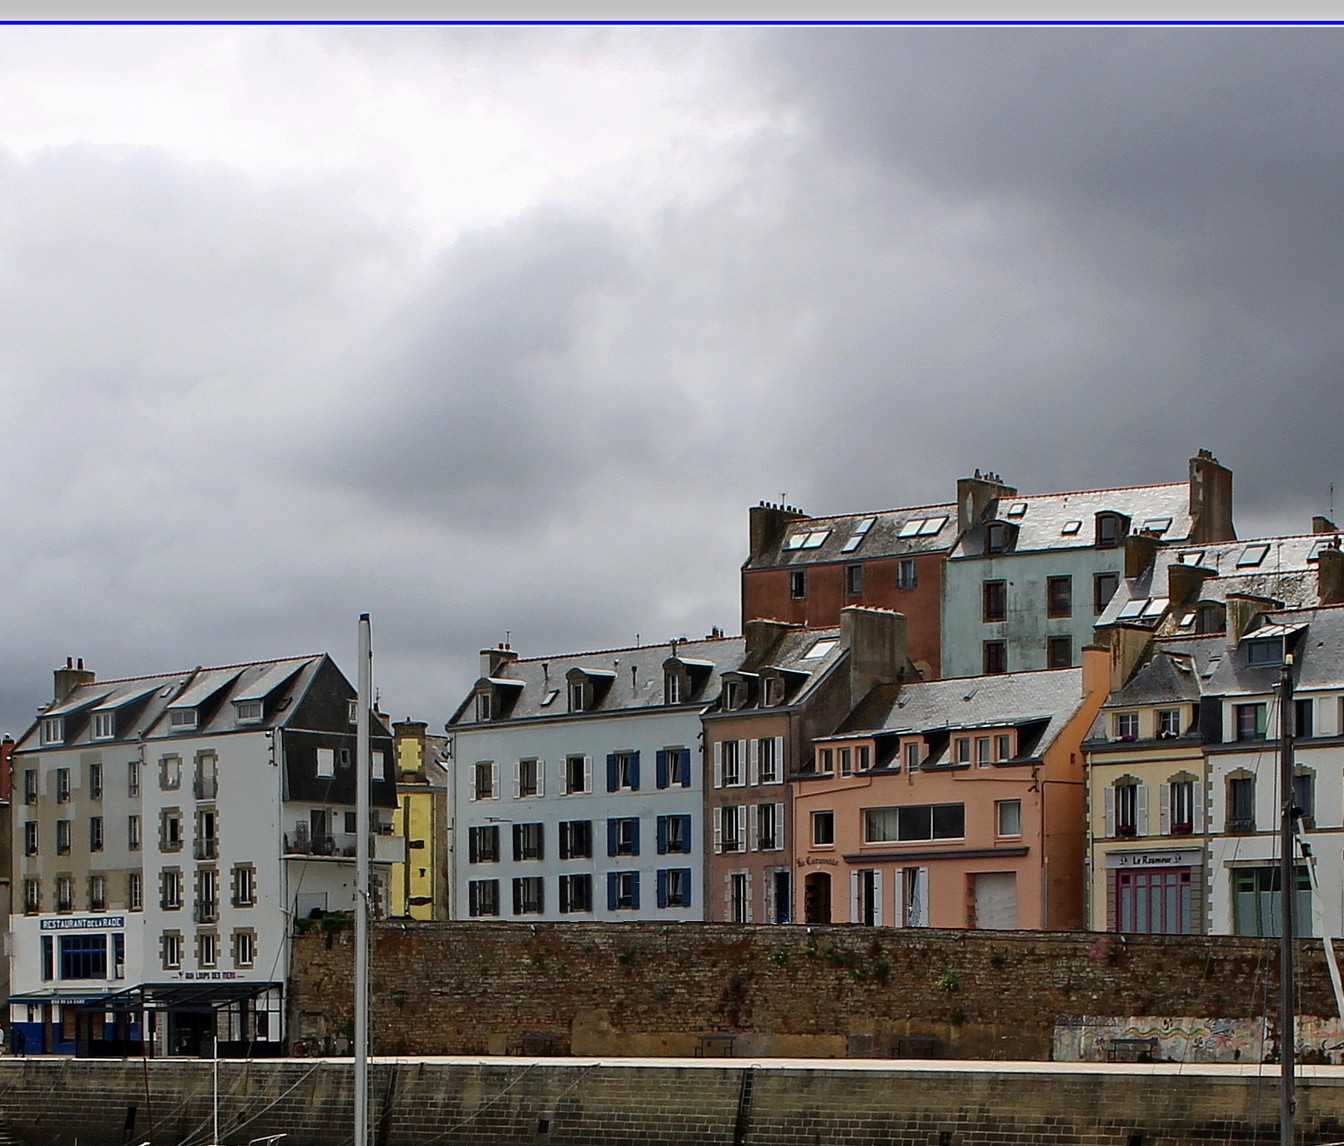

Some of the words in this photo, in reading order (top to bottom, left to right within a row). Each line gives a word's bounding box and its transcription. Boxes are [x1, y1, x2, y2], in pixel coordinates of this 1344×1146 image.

[1132, 856, 1141, 865] Le
[42, 919, 87, 929] RESTAURANT
[102, 918, 122, 927] RADE
[196, 971, 211, 980] LOUPS
[212, 971, 221, 980] DES
